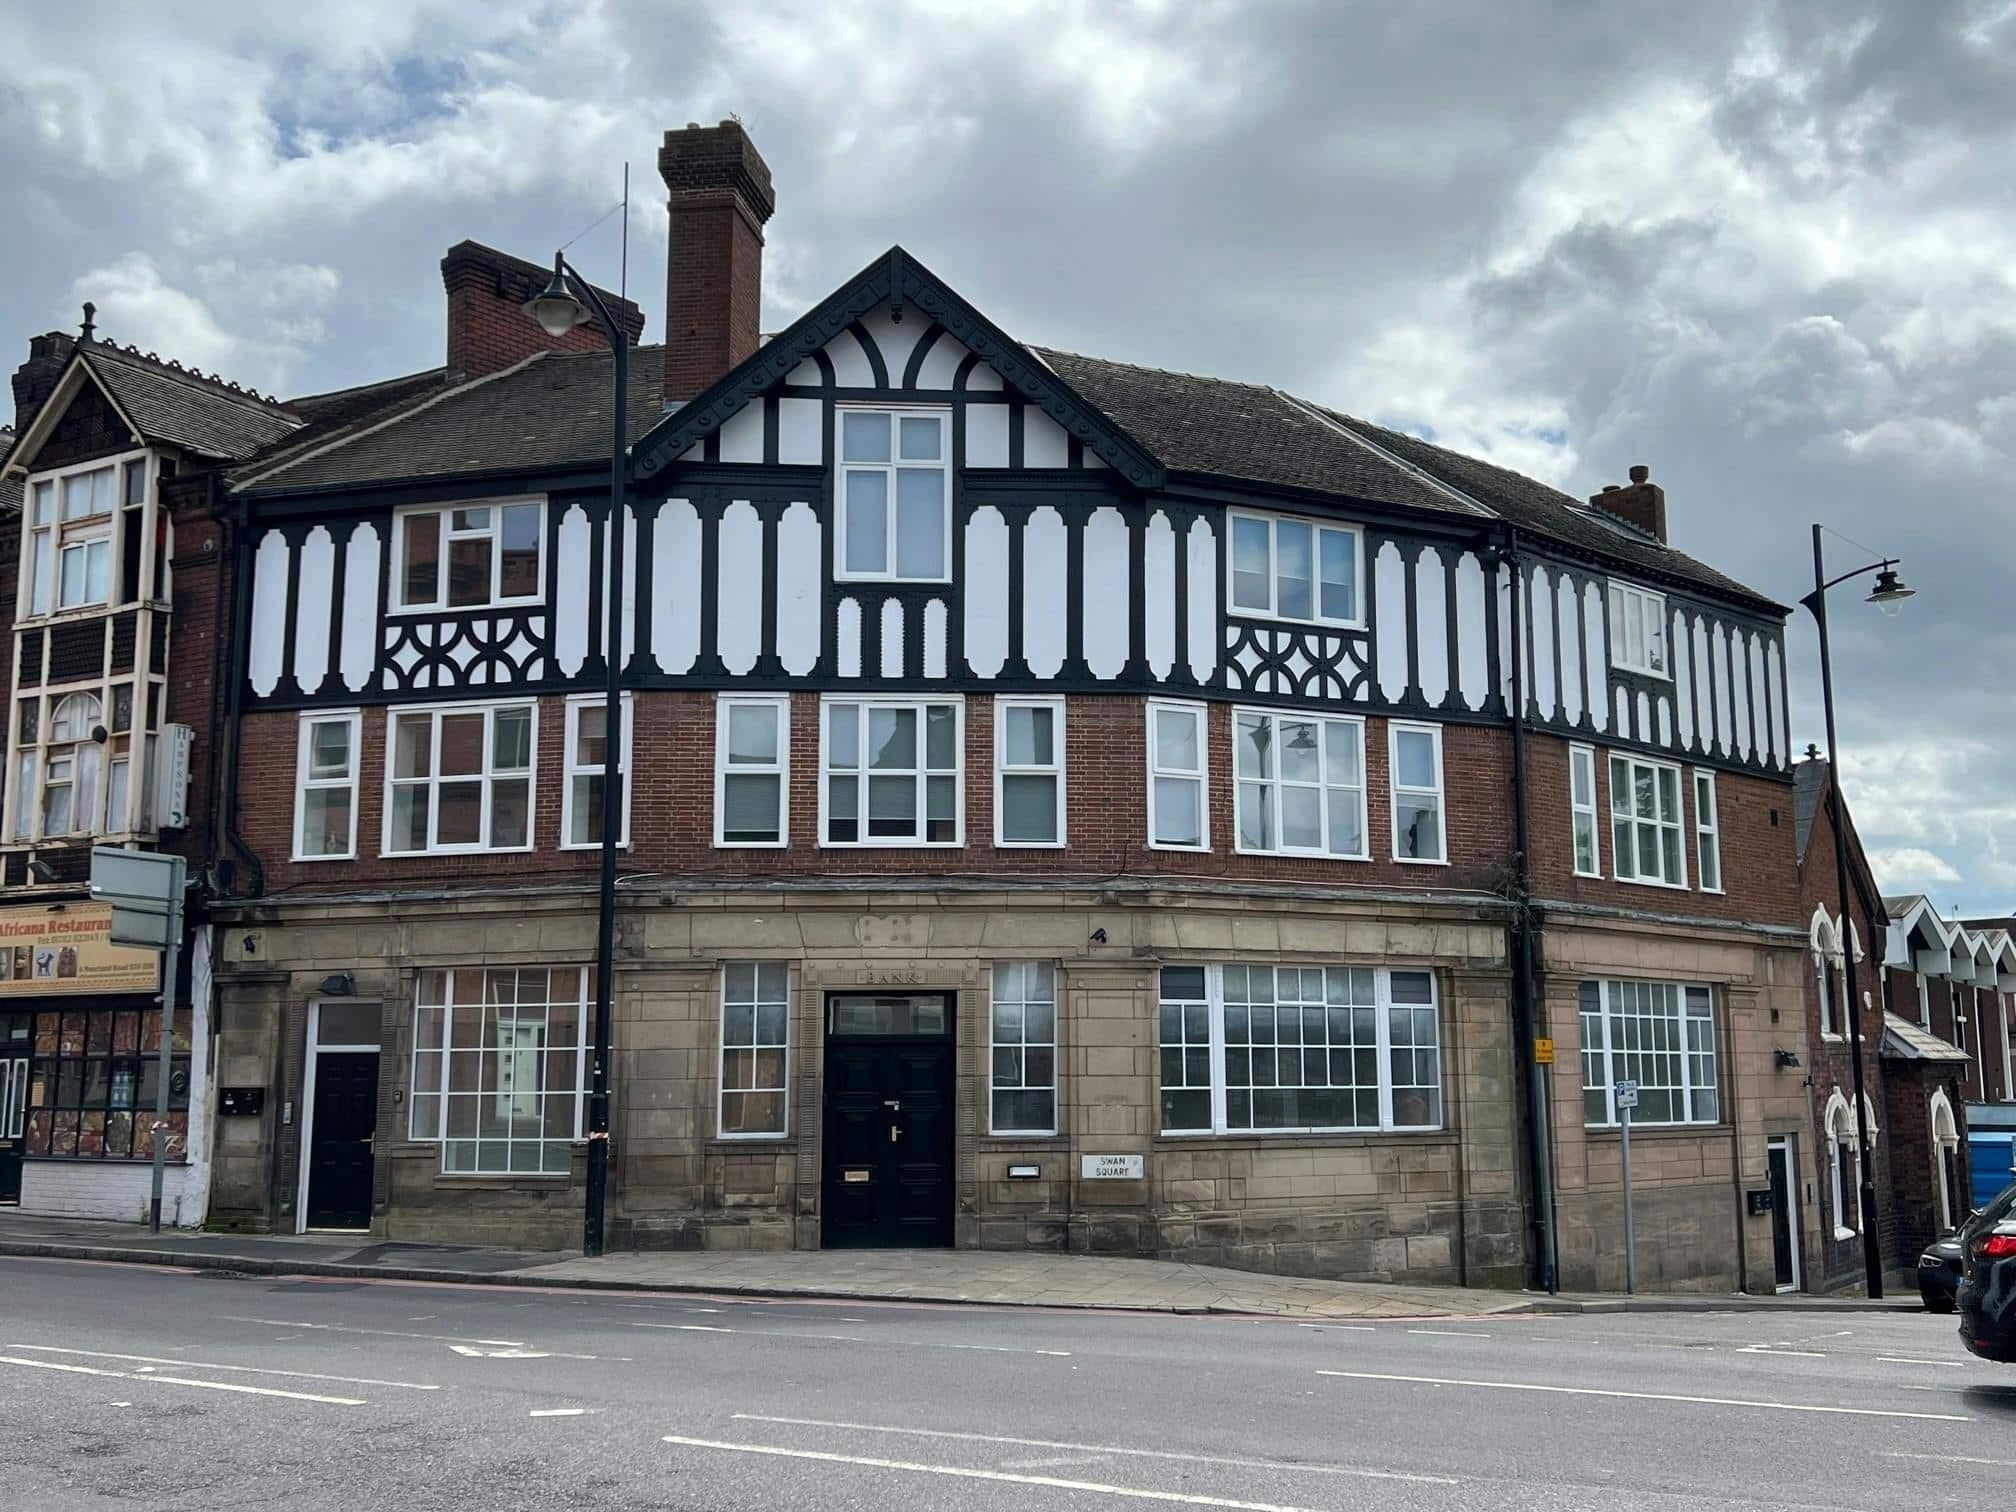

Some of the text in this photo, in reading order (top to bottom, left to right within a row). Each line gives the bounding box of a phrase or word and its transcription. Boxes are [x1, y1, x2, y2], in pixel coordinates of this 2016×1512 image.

[0, 919, 112, 936] Africana Restauran
[867, 971, 917, 984] BANK
[1099, 1157, 1126, 1165] SWAN
[1096, 1167, 1129, 1176] SQUARE
